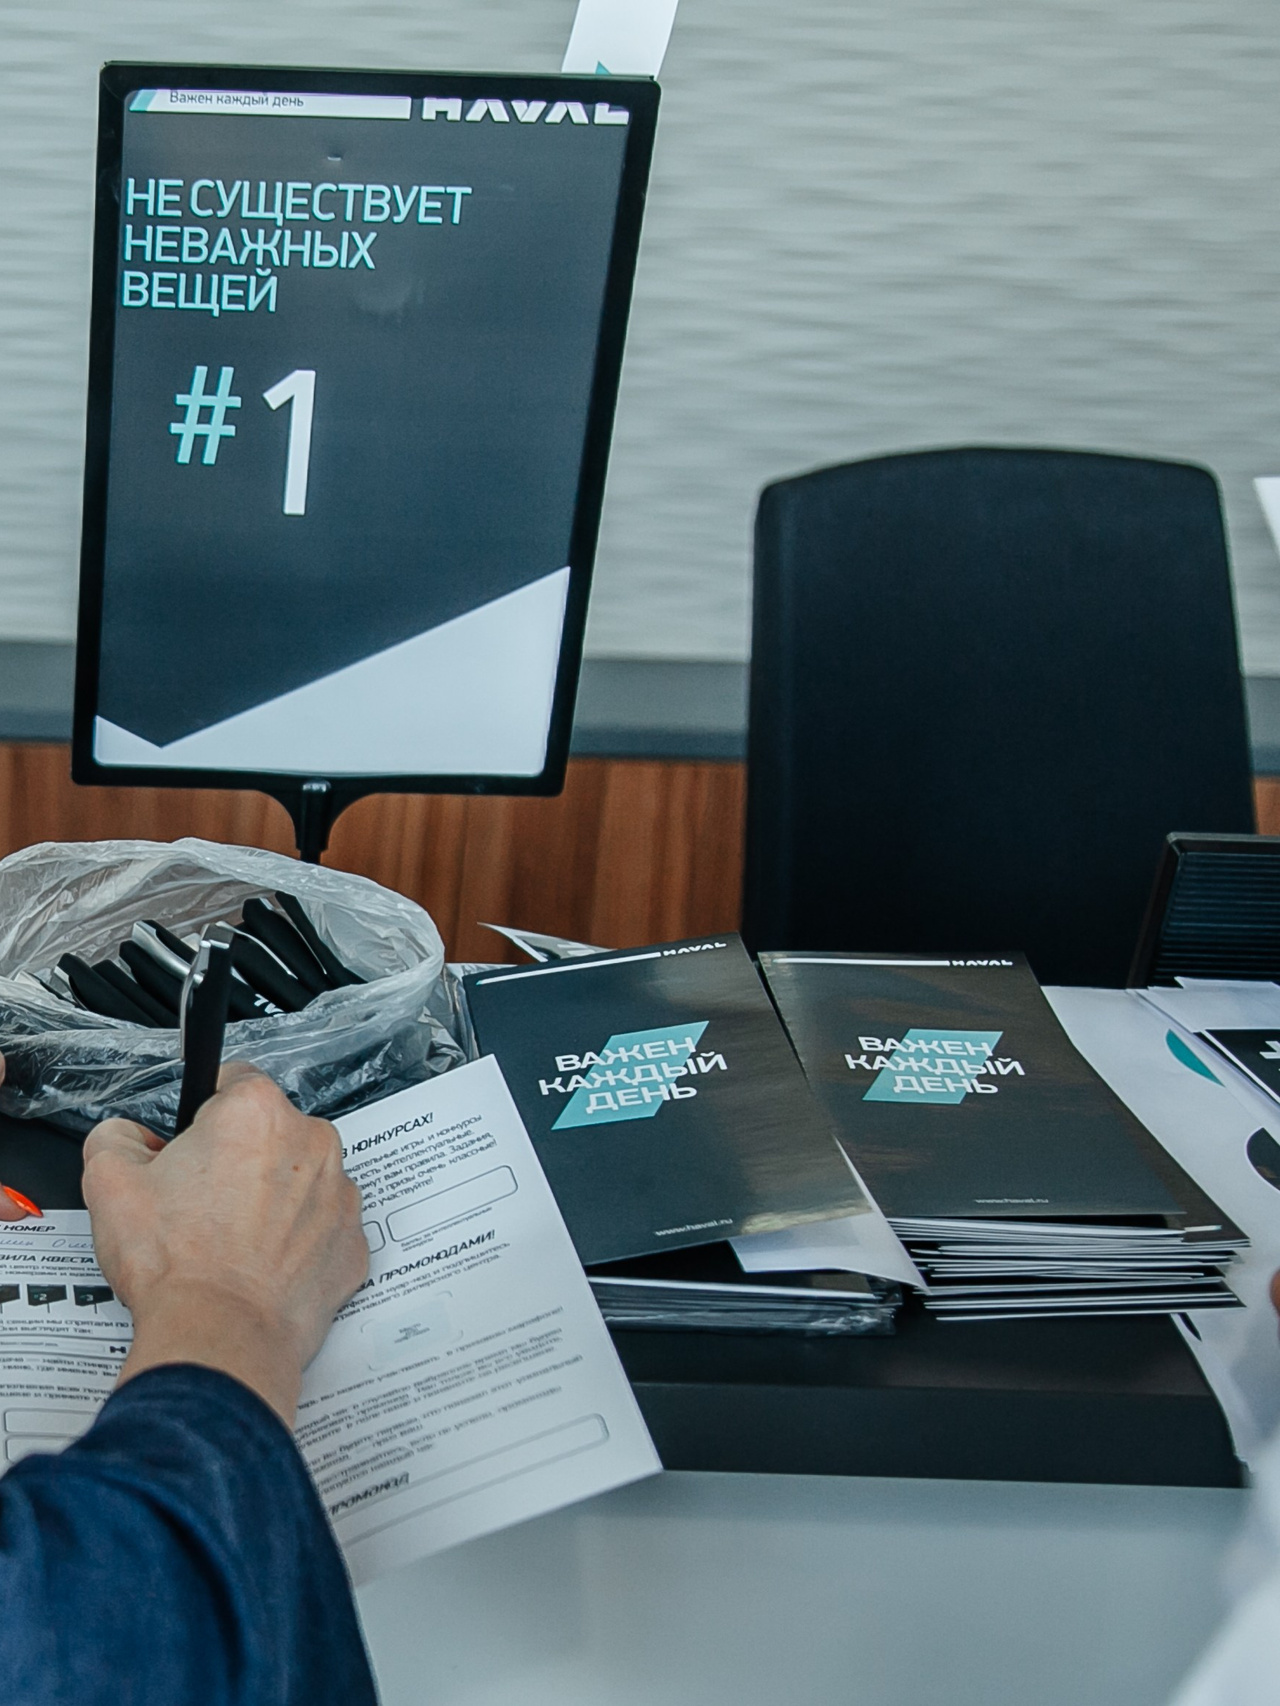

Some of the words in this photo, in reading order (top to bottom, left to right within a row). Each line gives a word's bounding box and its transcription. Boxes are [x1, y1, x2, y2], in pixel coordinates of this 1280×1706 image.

[170, 91, 213, 105] Важен
[216, 92, 268, 107] каждый
[272, 95, 304, 107] день
[125, 177, 184, 218] НЕ
[189, 178, 473, 228] СУЩЕСТВУЕТ
[124, 224, 378, 270] НЕВАЖНЫХ
[122, 268, 279, 318] ВЕЩЕЙ
[663, 942, 727, 957] HAVAL
[951, 959, 1014, 967] HAVAL
[554, 1036, 697, 1072] ВАЖЕН
[857, 1036, 994, 1057] ВАЖЕН
[538, 1051, 728, 1096] КАЖДЫЙ
[844, 1054, 1026, 1077] КАЖДЫЙ
[585, 1082, 698, 1115] ДЕНЬ
[893, 1075, 999, 1095] ДЕНЬ
[344, 1149, 399, 1175] екательные
[400, 1137, 426, 1155] игры
[436, 1114, 483, 1138] конкурсы
[351, 1112, 434, 1156] КОНКУРСАХ!
[359, 1176, 383, 1192] ажут
[384, 1168, 404, 1182] вам
[404, 1151, 448, 1176] правила.
[360, 1167, 382, 1180] есть
[417, 1163, 447, 1178] очень
[448, 1138, 498, 1165] классные!
[377, 1175, 434, 1207] участвуйте!
[654, 1218, 734, 1237] www.haval.ru
[379, 1229, 496, 1284] ПРОМОКОДАМИ!
[337, 1294, 370, 1313] тфон
